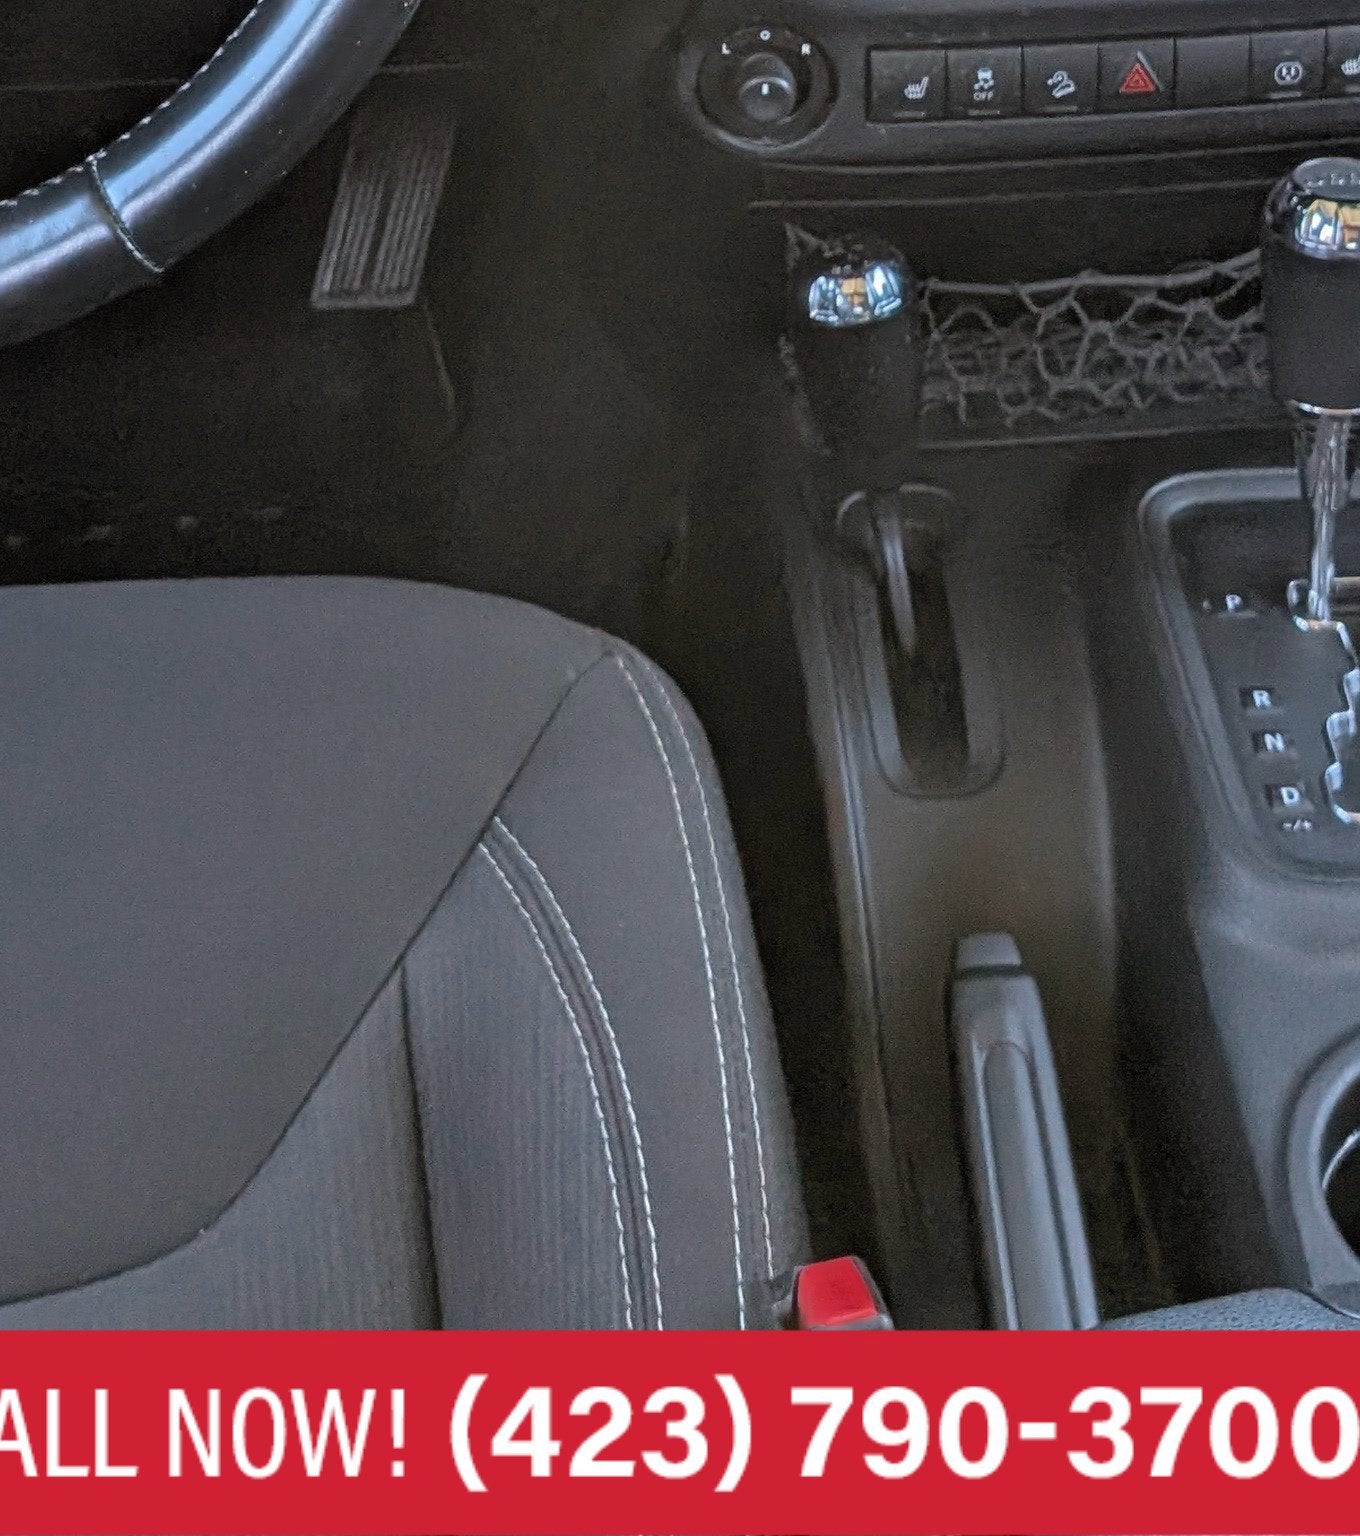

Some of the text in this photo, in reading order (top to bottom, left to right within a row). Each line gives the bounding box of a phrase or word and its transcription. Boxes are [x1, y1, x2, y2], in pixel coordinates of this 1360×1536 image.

[1253, 690, 1272, 708] R
[1265, 733, 1286, 752] N
[1280, 787, 1300, 806] D
